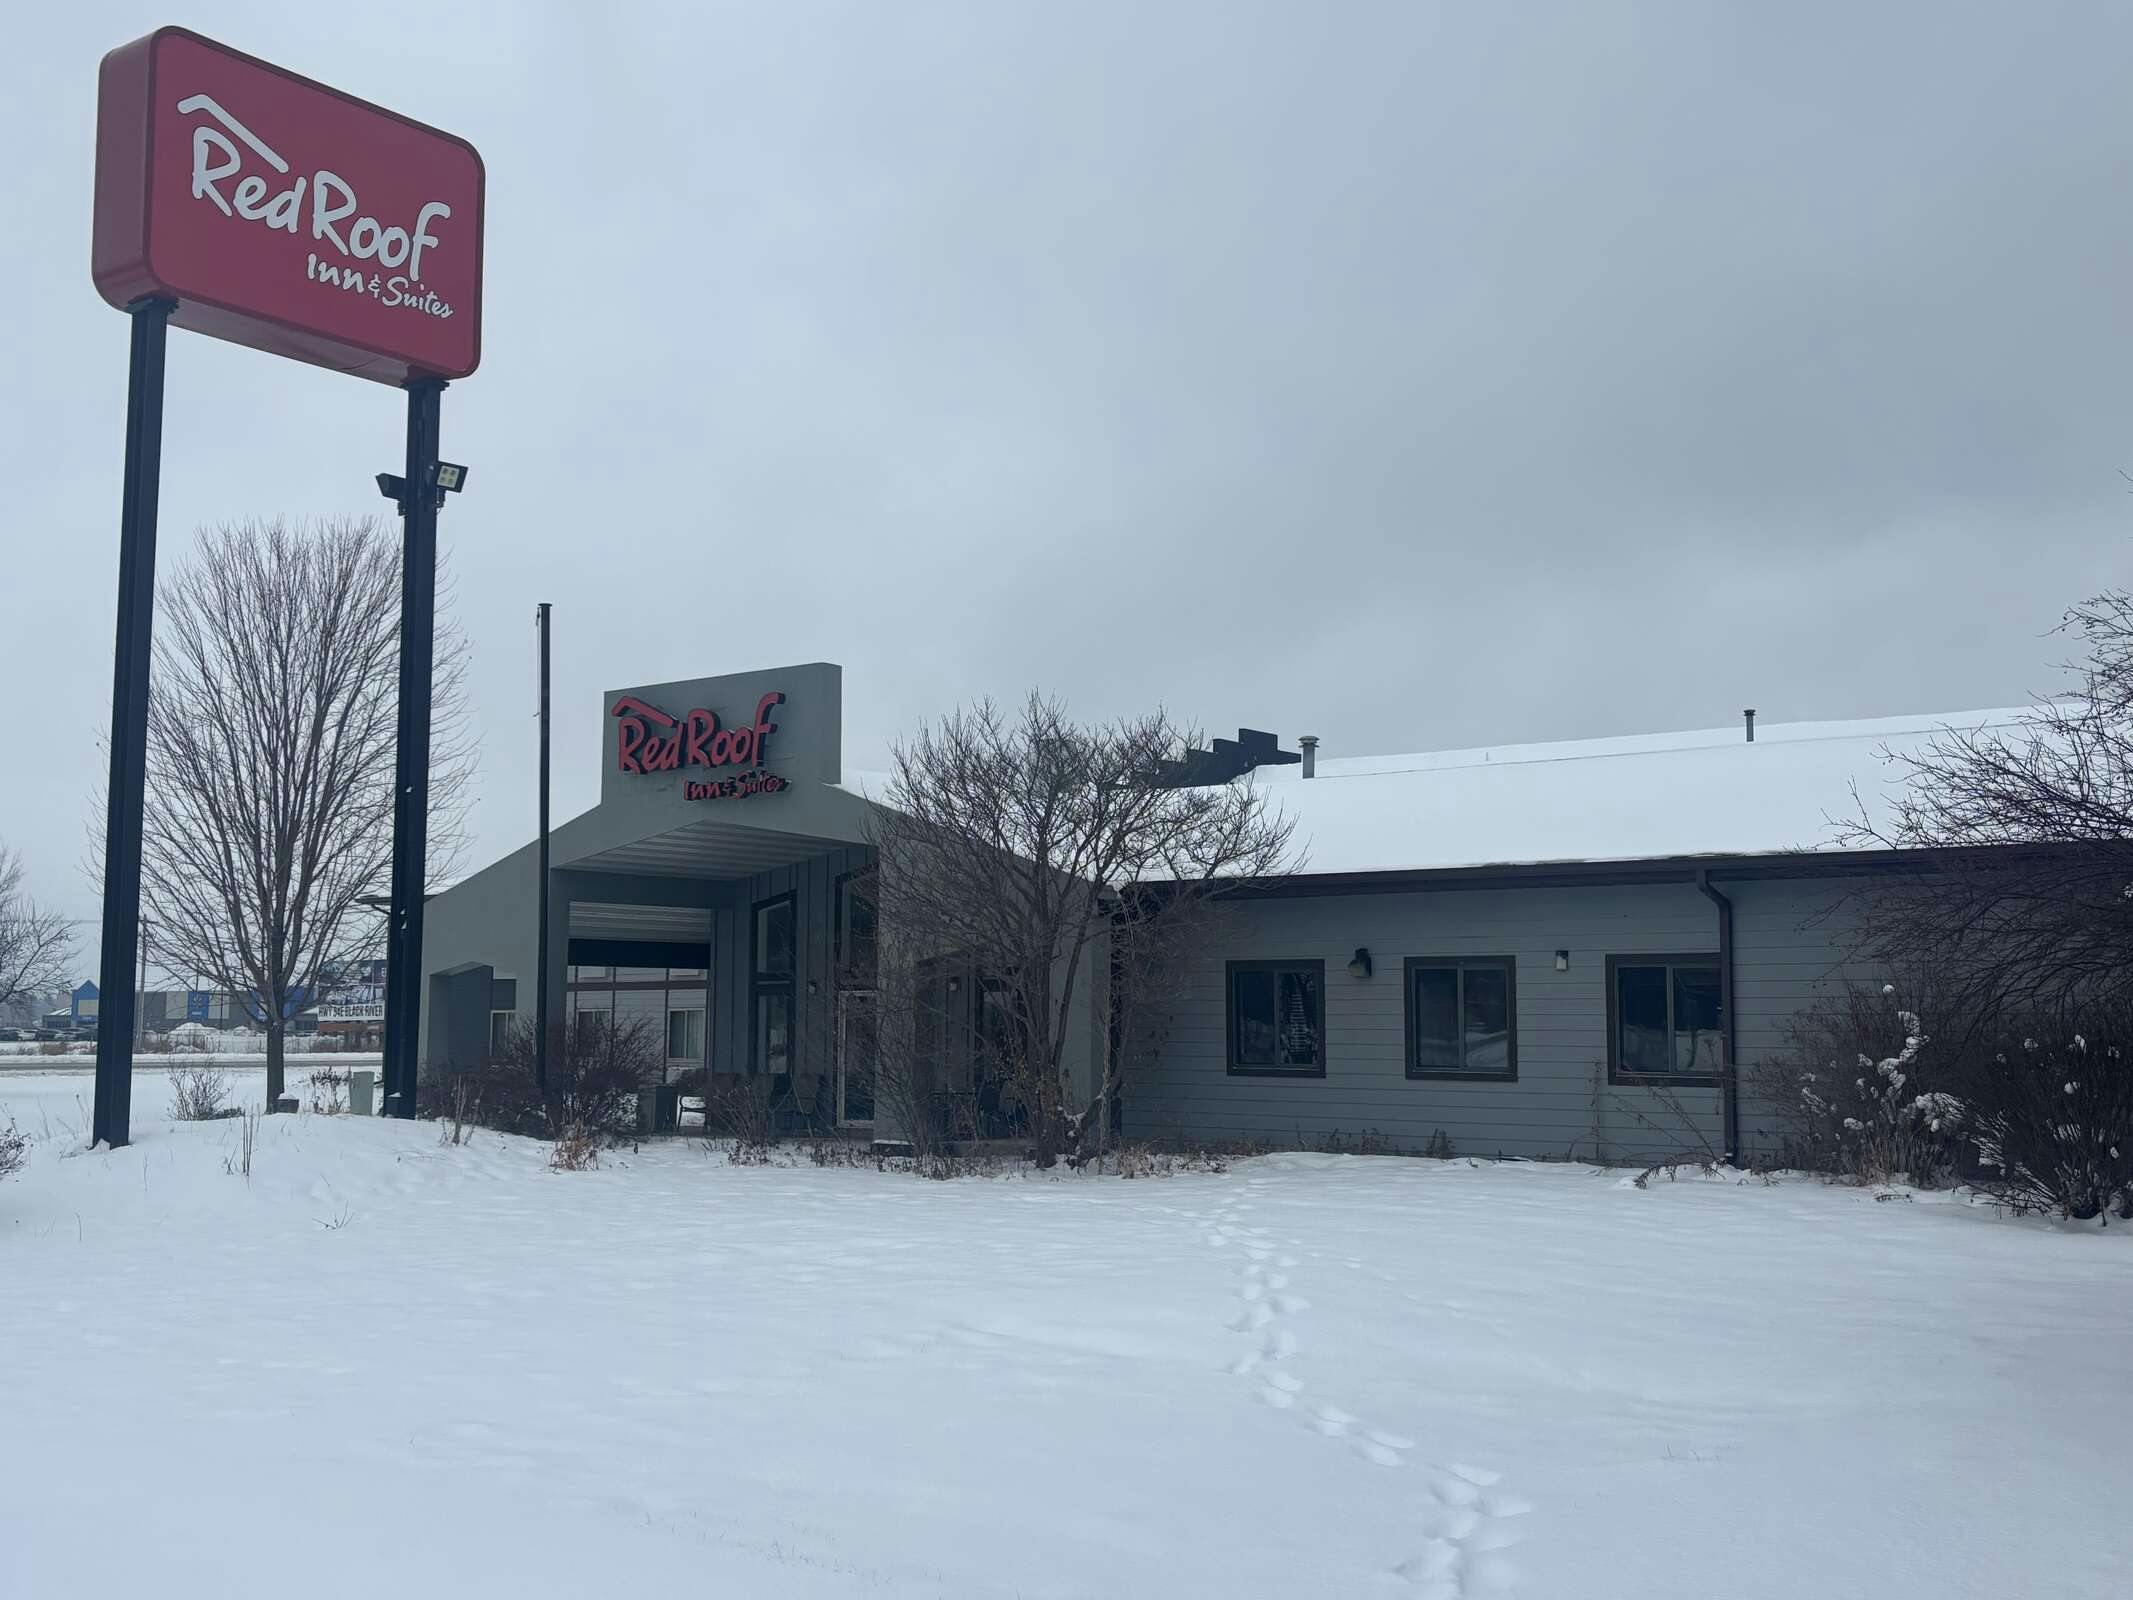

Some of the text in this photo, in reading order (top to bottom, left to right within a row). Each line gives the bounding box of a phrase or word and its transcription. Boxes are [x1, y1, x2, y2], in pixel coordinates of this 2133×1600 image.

[192, 126, 451, 282] Red Roof
[307, 253, 454, 319] Inn & Suites
[619, 692, 785, 774] Red Roof
[683, 779, 720, 800] Inn
[736, 769, 788, 799] Suites
